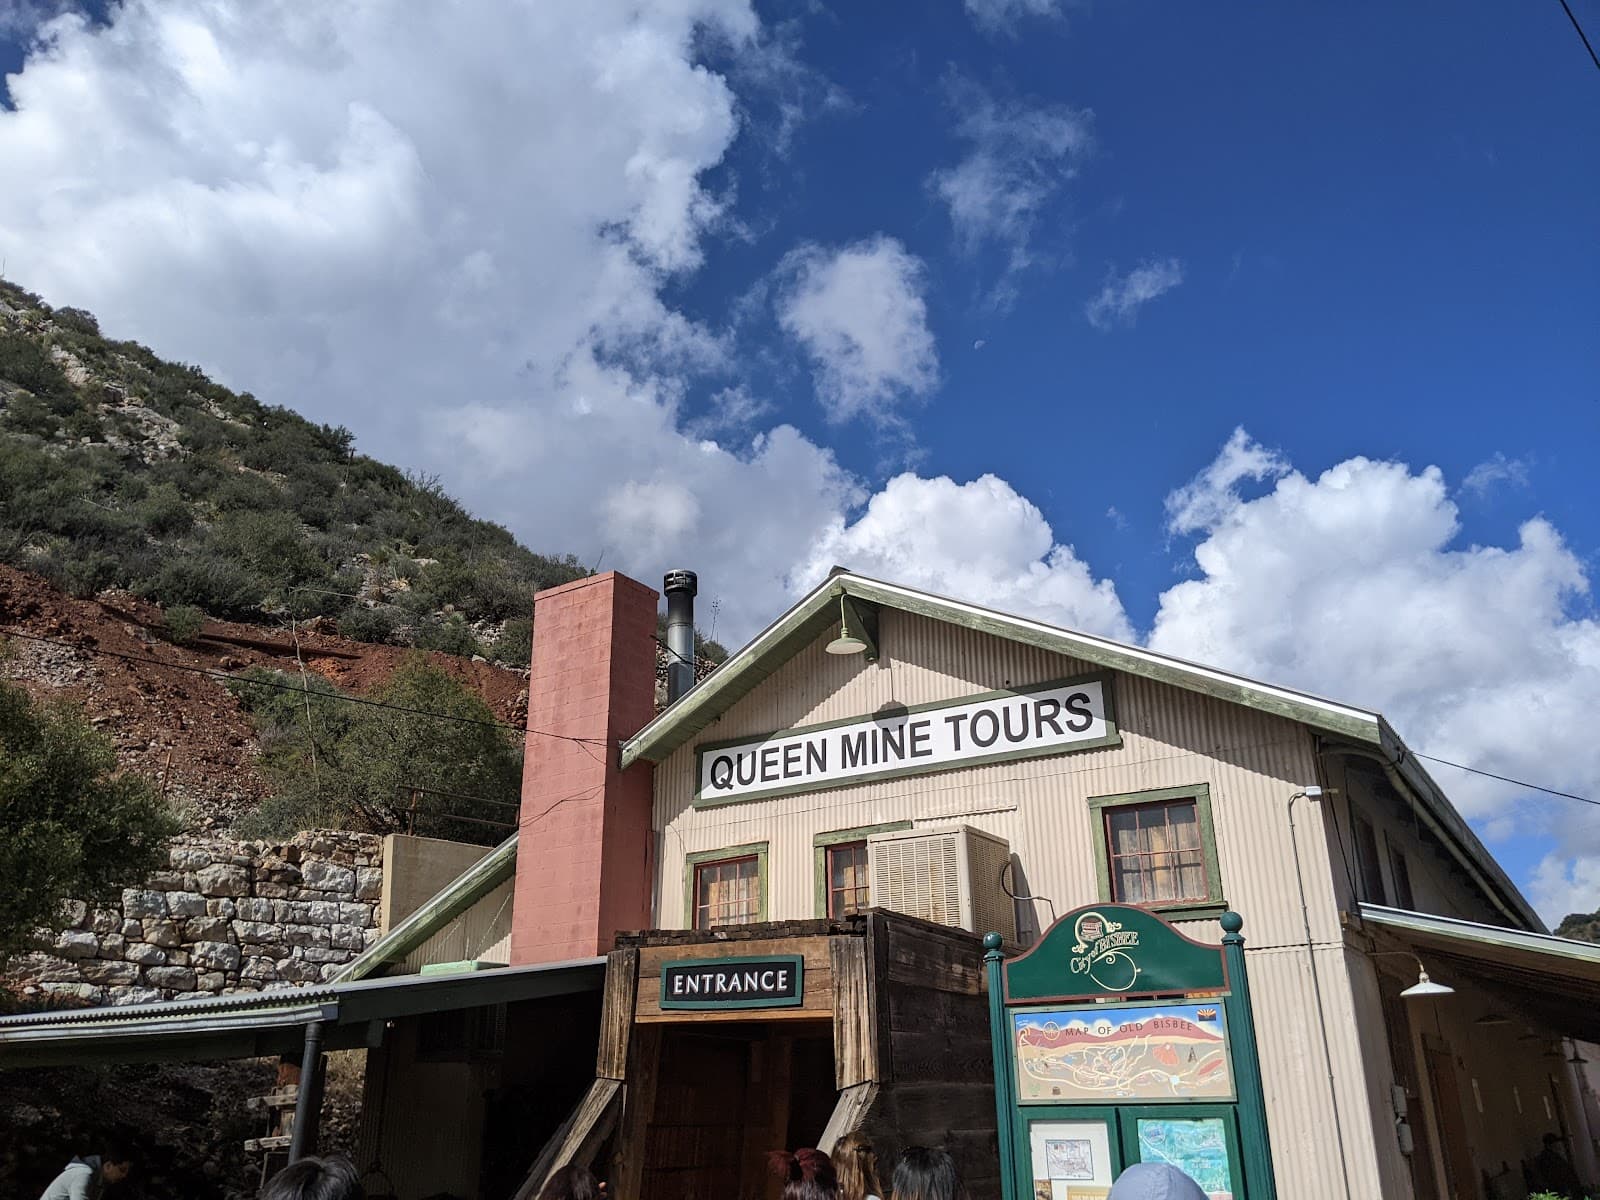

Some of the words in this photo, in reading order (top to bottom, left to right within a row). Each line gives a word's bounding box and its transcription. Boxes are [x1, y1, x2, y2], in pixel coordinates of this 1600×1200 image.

[710, 738, 827, 790] QUEEN
[841, 719, 933, 770] MINE
[945, 692, 1094, 751] TOURS
[1070, 953, 1091, 974] City
[1099, 931, 1140, 953] BISBEE
[673, 970, 788, 995] ENTRANCE
[1065, 1026, 1089, 1037] MAP
[1098, 1025, 1112, 1035] OF
[1119, 1022, 1143, 1033] OLD
[1153, 1019, 1193, 1031] BISBEE
